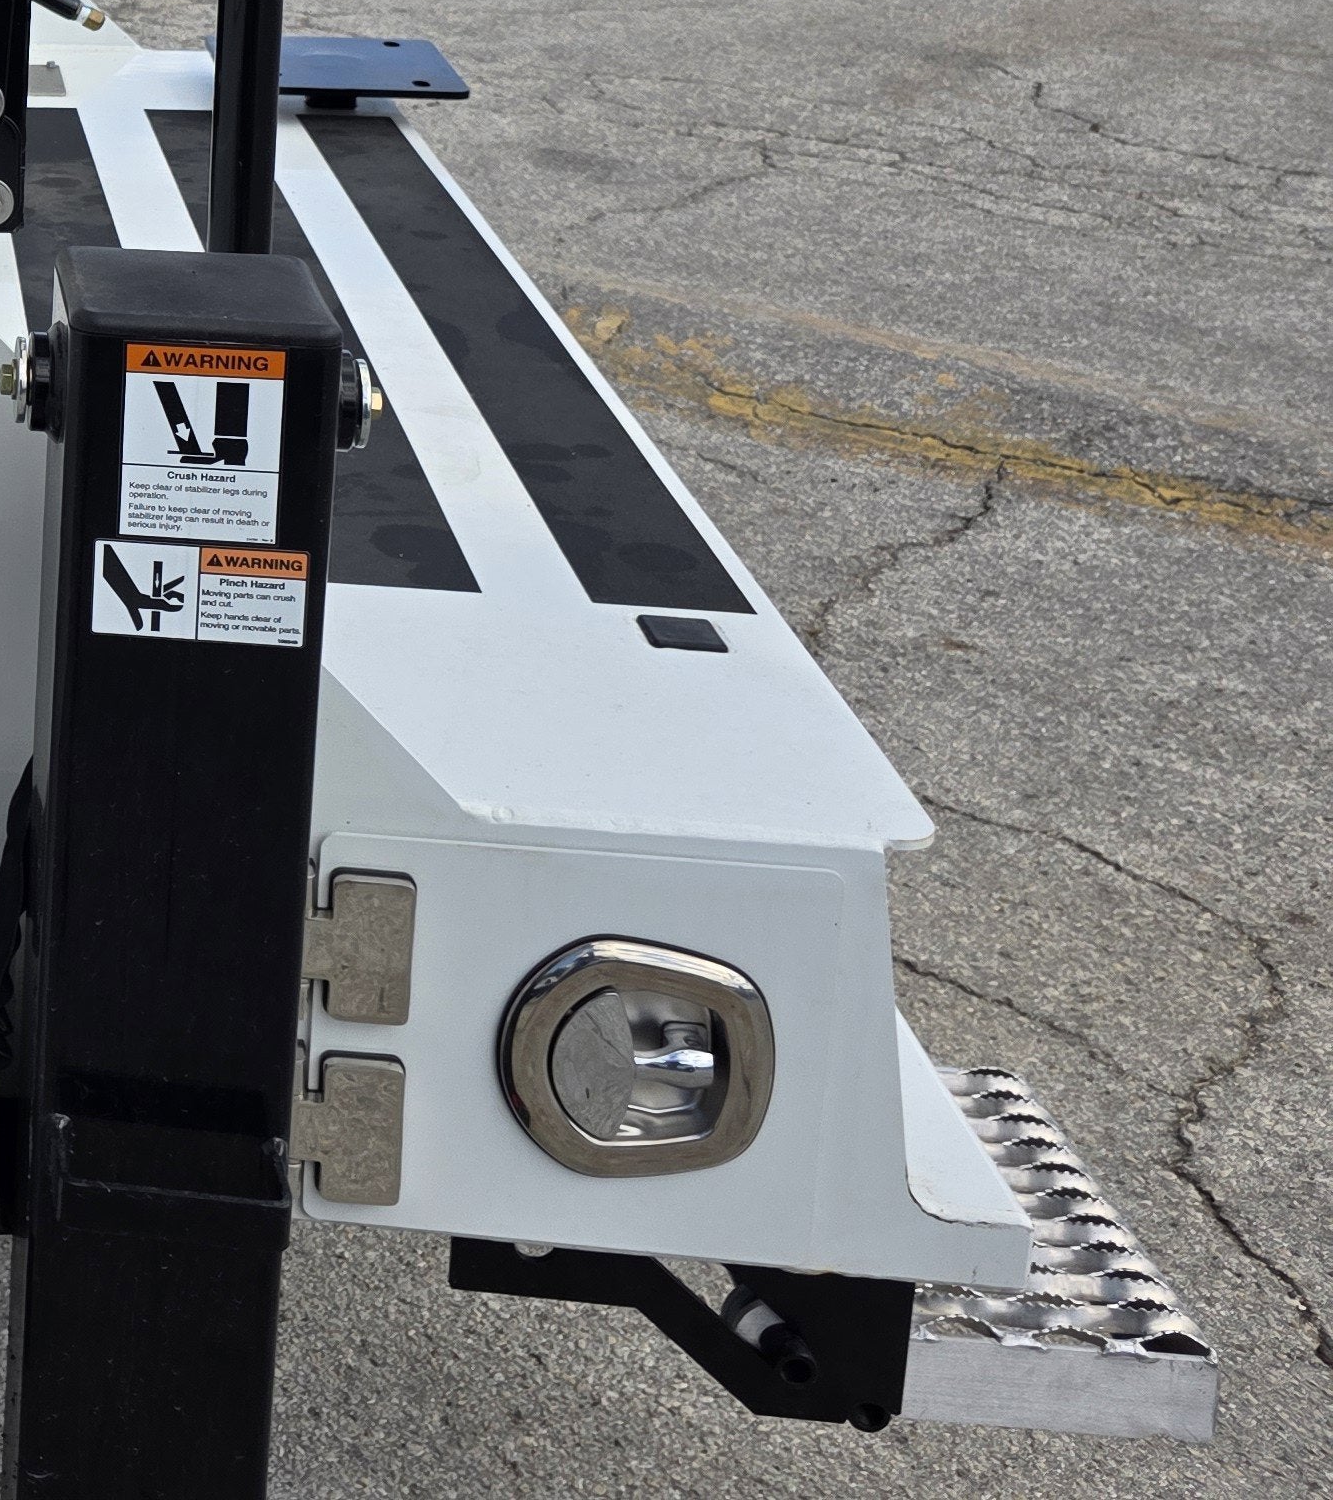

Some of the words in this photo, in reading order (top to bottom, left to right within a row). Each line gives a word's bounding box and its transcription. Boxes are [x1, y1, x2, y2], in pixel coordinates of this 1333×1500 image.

[163, 352, 269, 371] WARNING
[167, 471, 198, 481] Crush
[201, 473, 236, 483] Hazard
[128, 491, 169, 500] operation.
[129, 482, 150, 491] Keep
[152, 483, 172, 491] clear
[174, 484, 183, 492] of
[185, 485, 221, 494] stabilizer
[222, 487, 240, 496] legs
[241, 488, 268, 498] during
[128, 503, 156, 512] Failure
[168, 505, 188, 514] keep
[190, 506, 210, 514] clear
[222, 509, 252, 518] moving
[127, 512, 163, 520] stabilizer
[165, 514, 183, 523] legs
[226, 517, 233, 525] in
[235, 518, 259, 526] death
[127, 520, 156, 529] serious
[158, 523, 183, 532] injury.
[225, 555, 303, 571] WARNING
[219, 578, 248, 588] Pinch
[250, 580, 286, 590] Hazard
[201, 589, 231, 599] Moving
[233, 591, 254, 600] parts
[256, 593, 272, 601] can
[273, 594, 296, 602] crush
[218, 600, 234, 608] cut.
[200, 611, 222, 621] Keep
[224, 612, 249, 621] hands
[251, 615, 272, 623] clear
[200, 622, 230, 632] moving
[241, 624, 277, 633] movable
[278, 627, 301, 635] parts.
